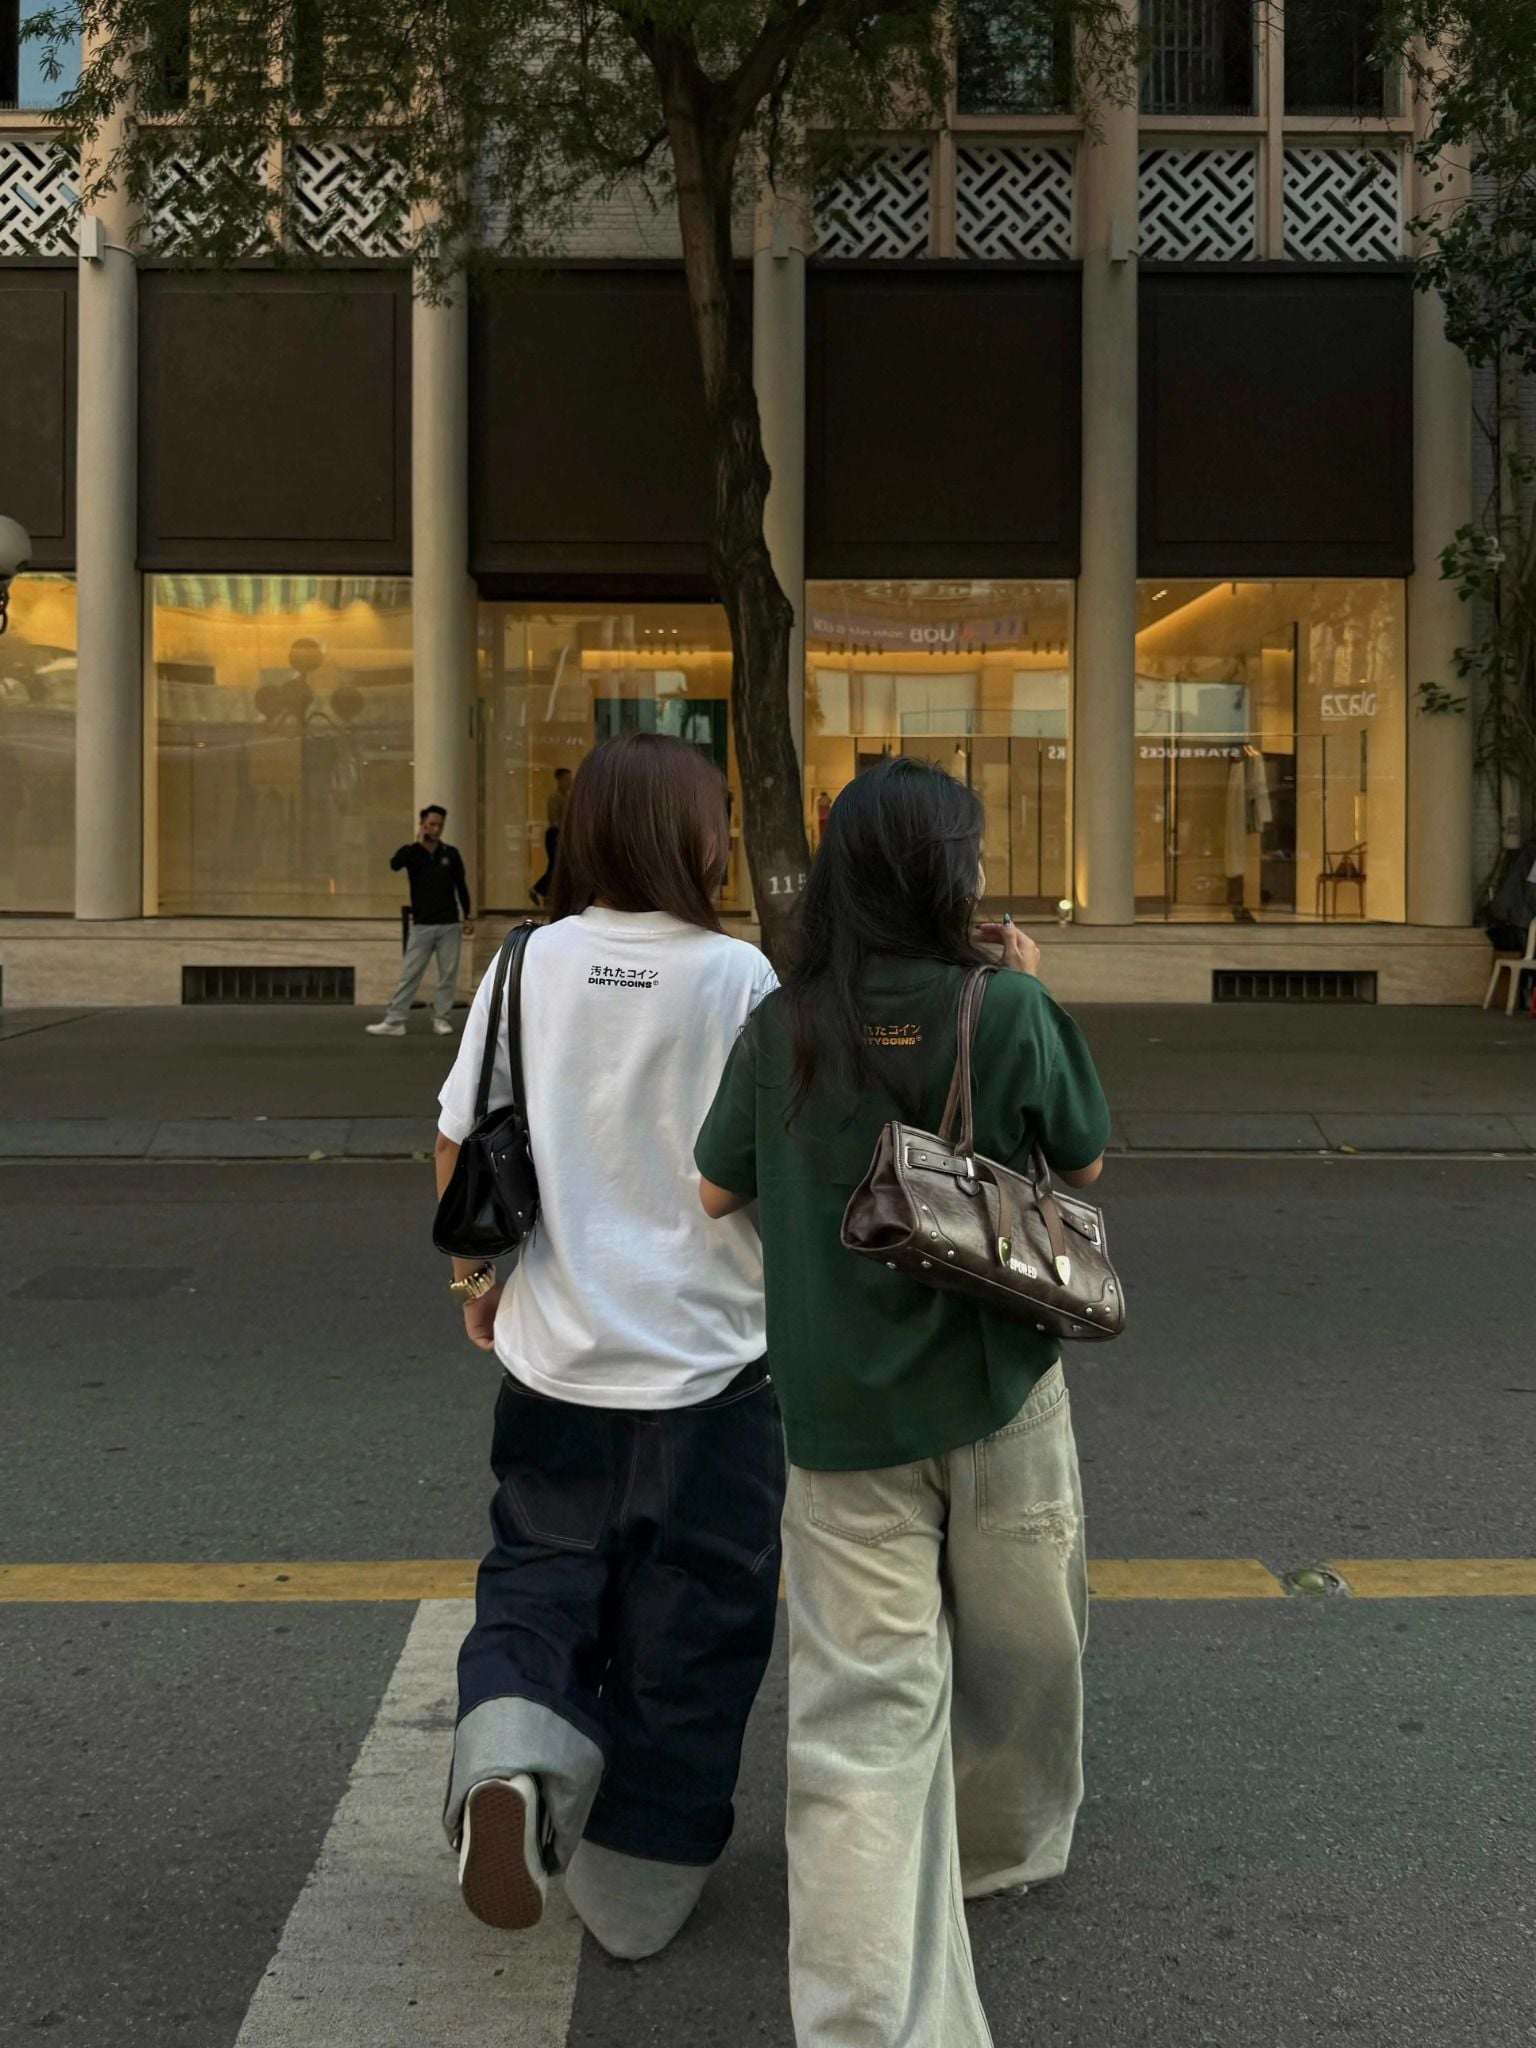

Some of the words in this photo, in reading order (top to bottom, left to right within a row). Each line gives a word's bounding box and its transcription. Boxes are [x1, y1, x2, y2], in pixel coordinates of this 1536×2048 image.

[590, 965, 659, 979] 汚れたコイン
[863, 1024, 921, 1036] れたコイン
